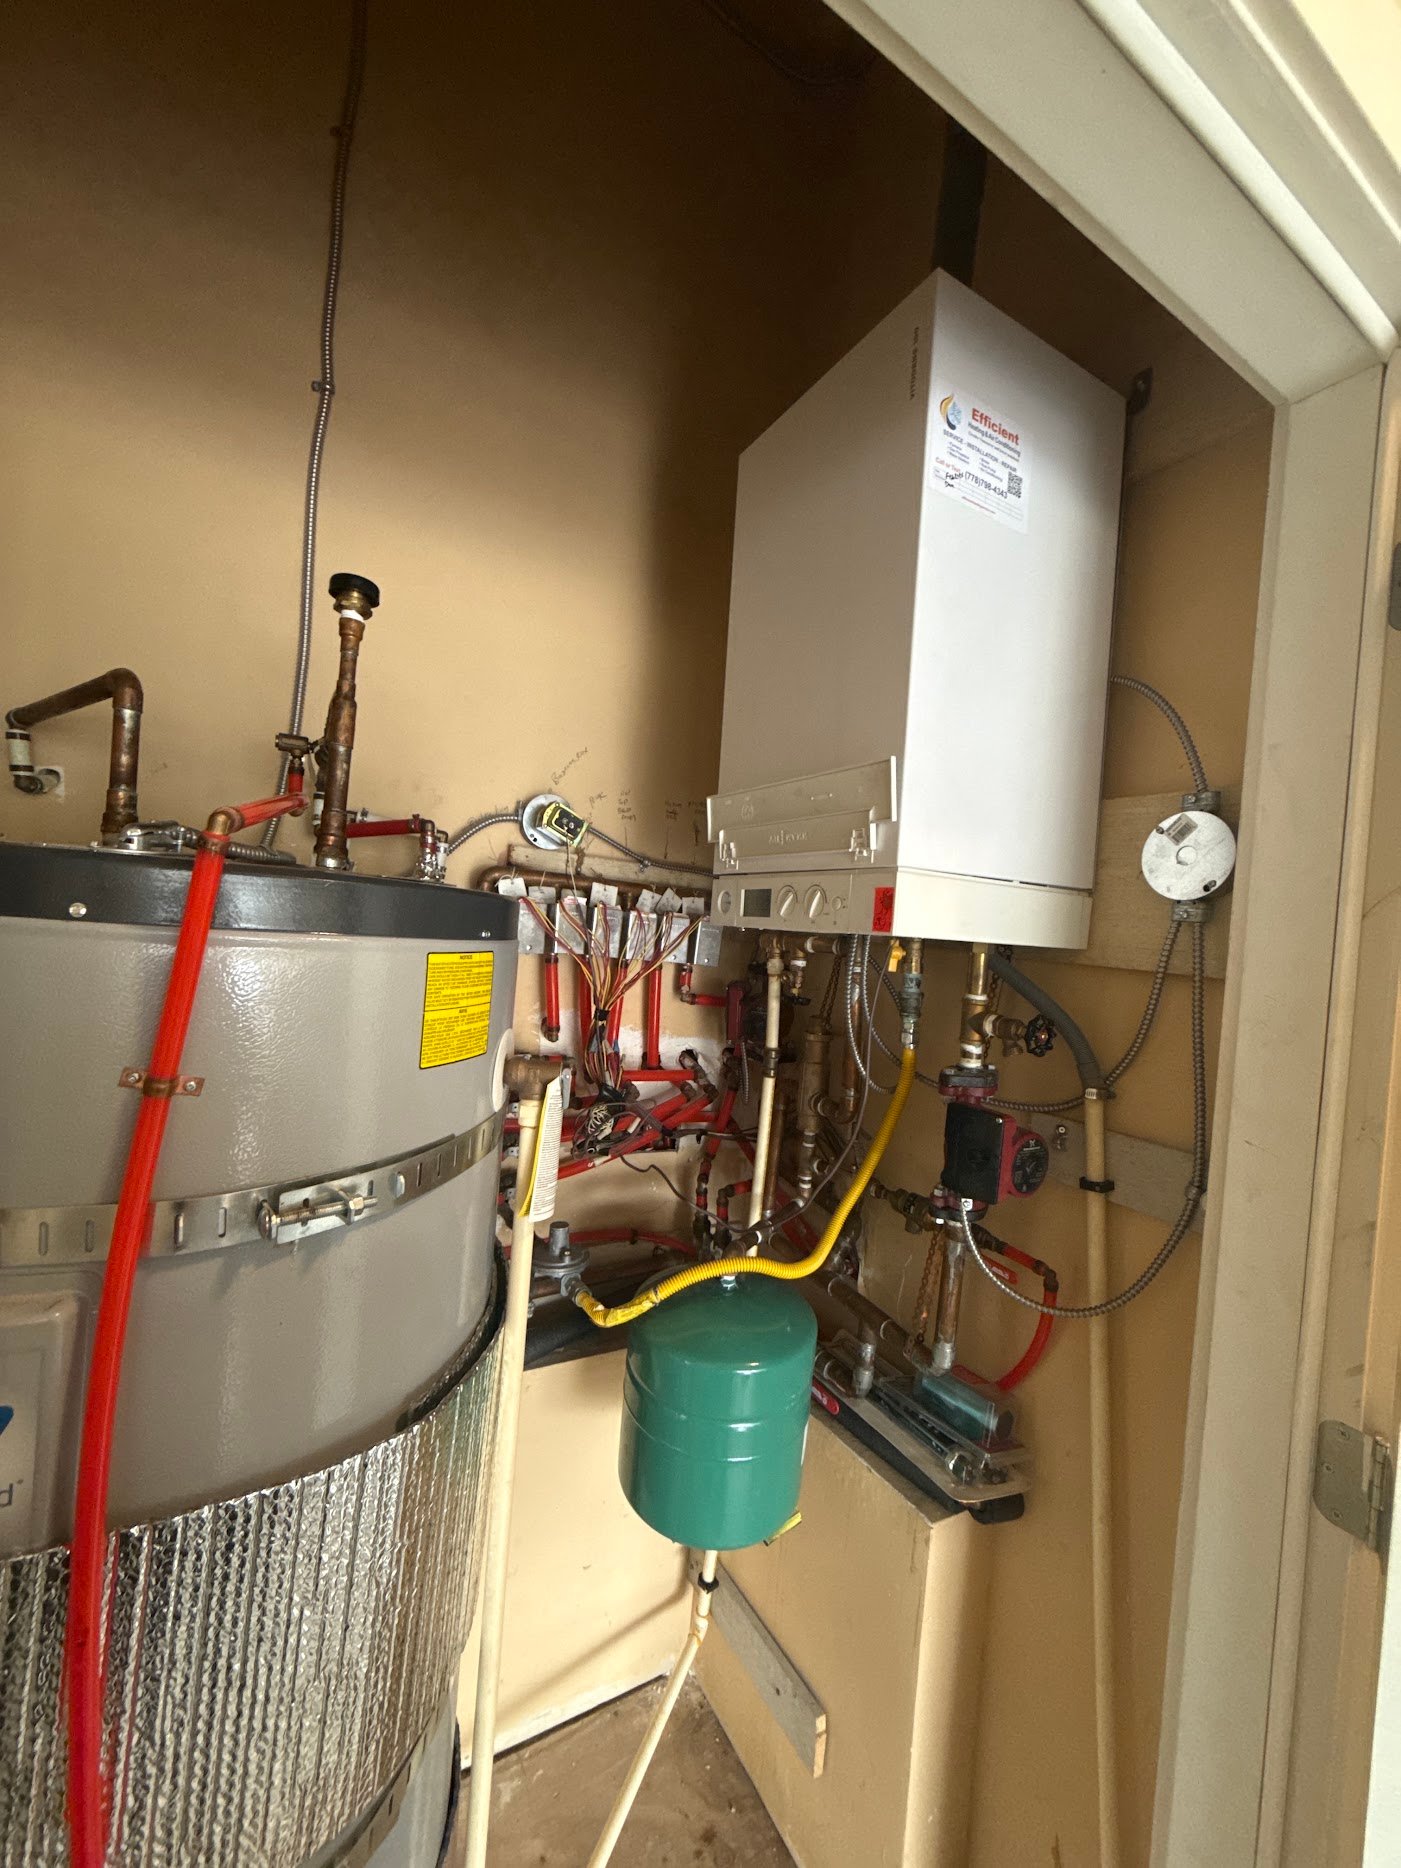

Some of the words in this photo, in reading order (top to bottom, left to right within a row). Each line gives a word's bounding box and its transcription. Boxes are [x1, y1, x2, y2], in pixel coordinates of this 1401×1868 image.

[972, 408, 1020, 445] Efficient
[943, 429, 963, 444] SERVICE
[966, 441, 998, 463] INSTALLATION
[1001, 460, 1017, 472] REPAIR
